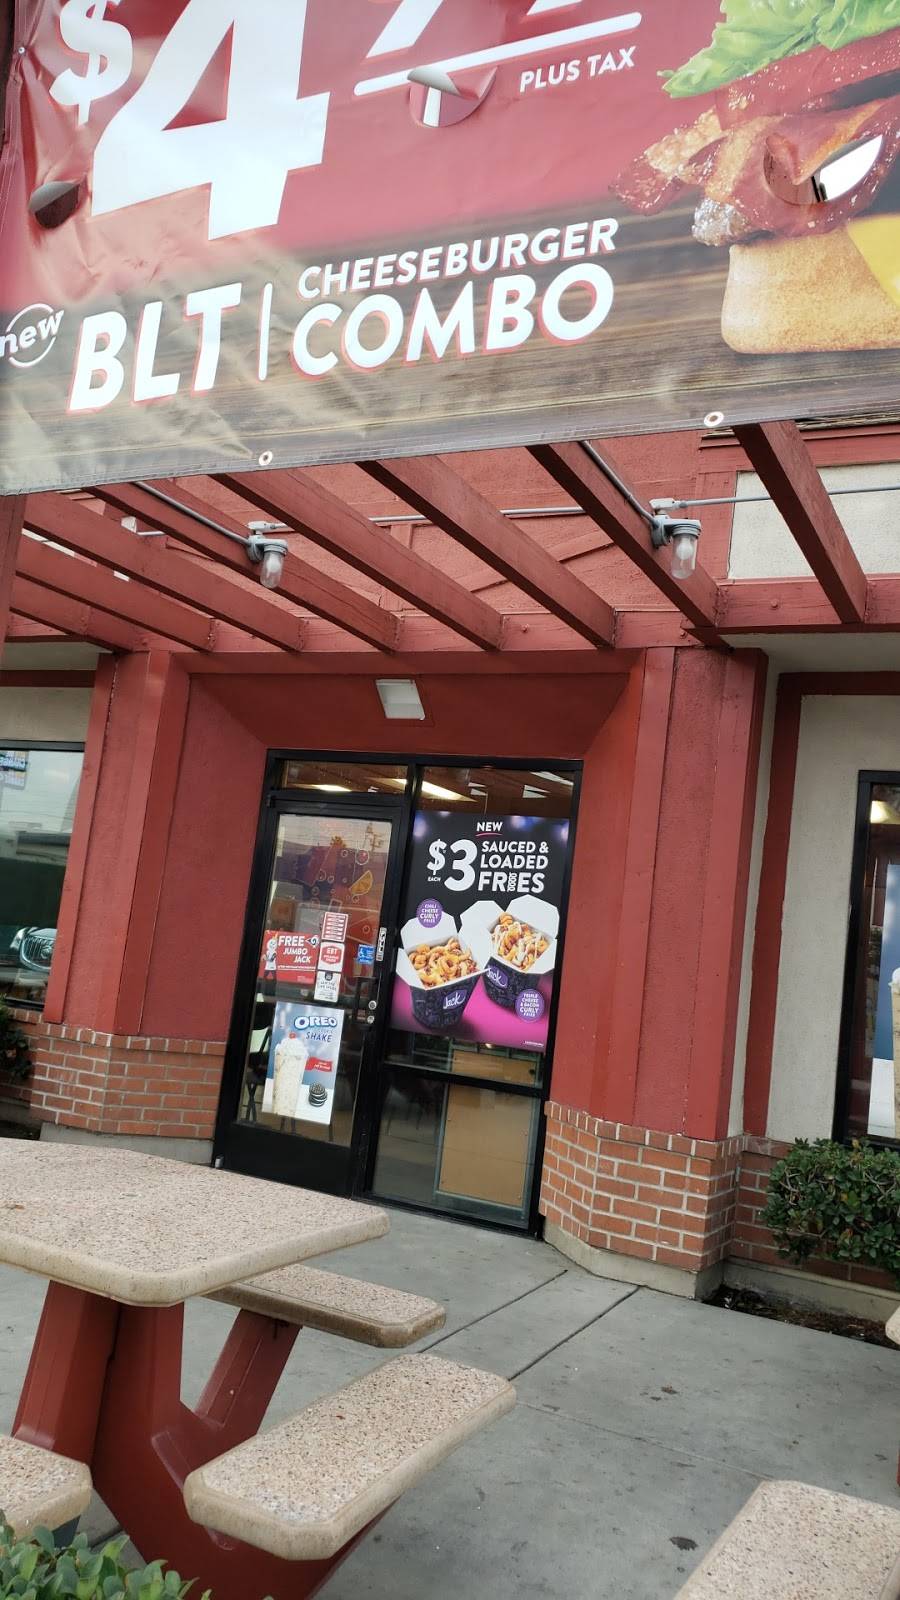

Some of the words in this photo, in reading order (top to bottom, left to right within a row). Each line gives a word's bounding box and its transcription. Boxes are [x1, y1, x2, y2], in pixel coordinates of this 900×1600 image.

[519, 60, 580, 93] PLUS
[587, 46, 637, 78] TAX
[297, 217, 620, 299] CHEESEBURGER
[291, 262, 615, 379] COMBO
[0, 309, 65, 358] new
[67, 282, 243, 413] BLT
[476, 821, 504, 832] NEW
[481, 840, 536, 854] SAUCED
[538, 841, 550, 853] &
[480, 853, 549, 870] LOADED
[477, 870, 546, 894] FRIES
[278, 935, 306, 947] FREE
[283, 947, 309, 956] JUMBO
[293, 955, 312, 964] JACK
[443, 991, 467, 1009] Jack
[294, 1015, 338, 1031] OREO
[305, 1031, 333, 1043] SHAKE
